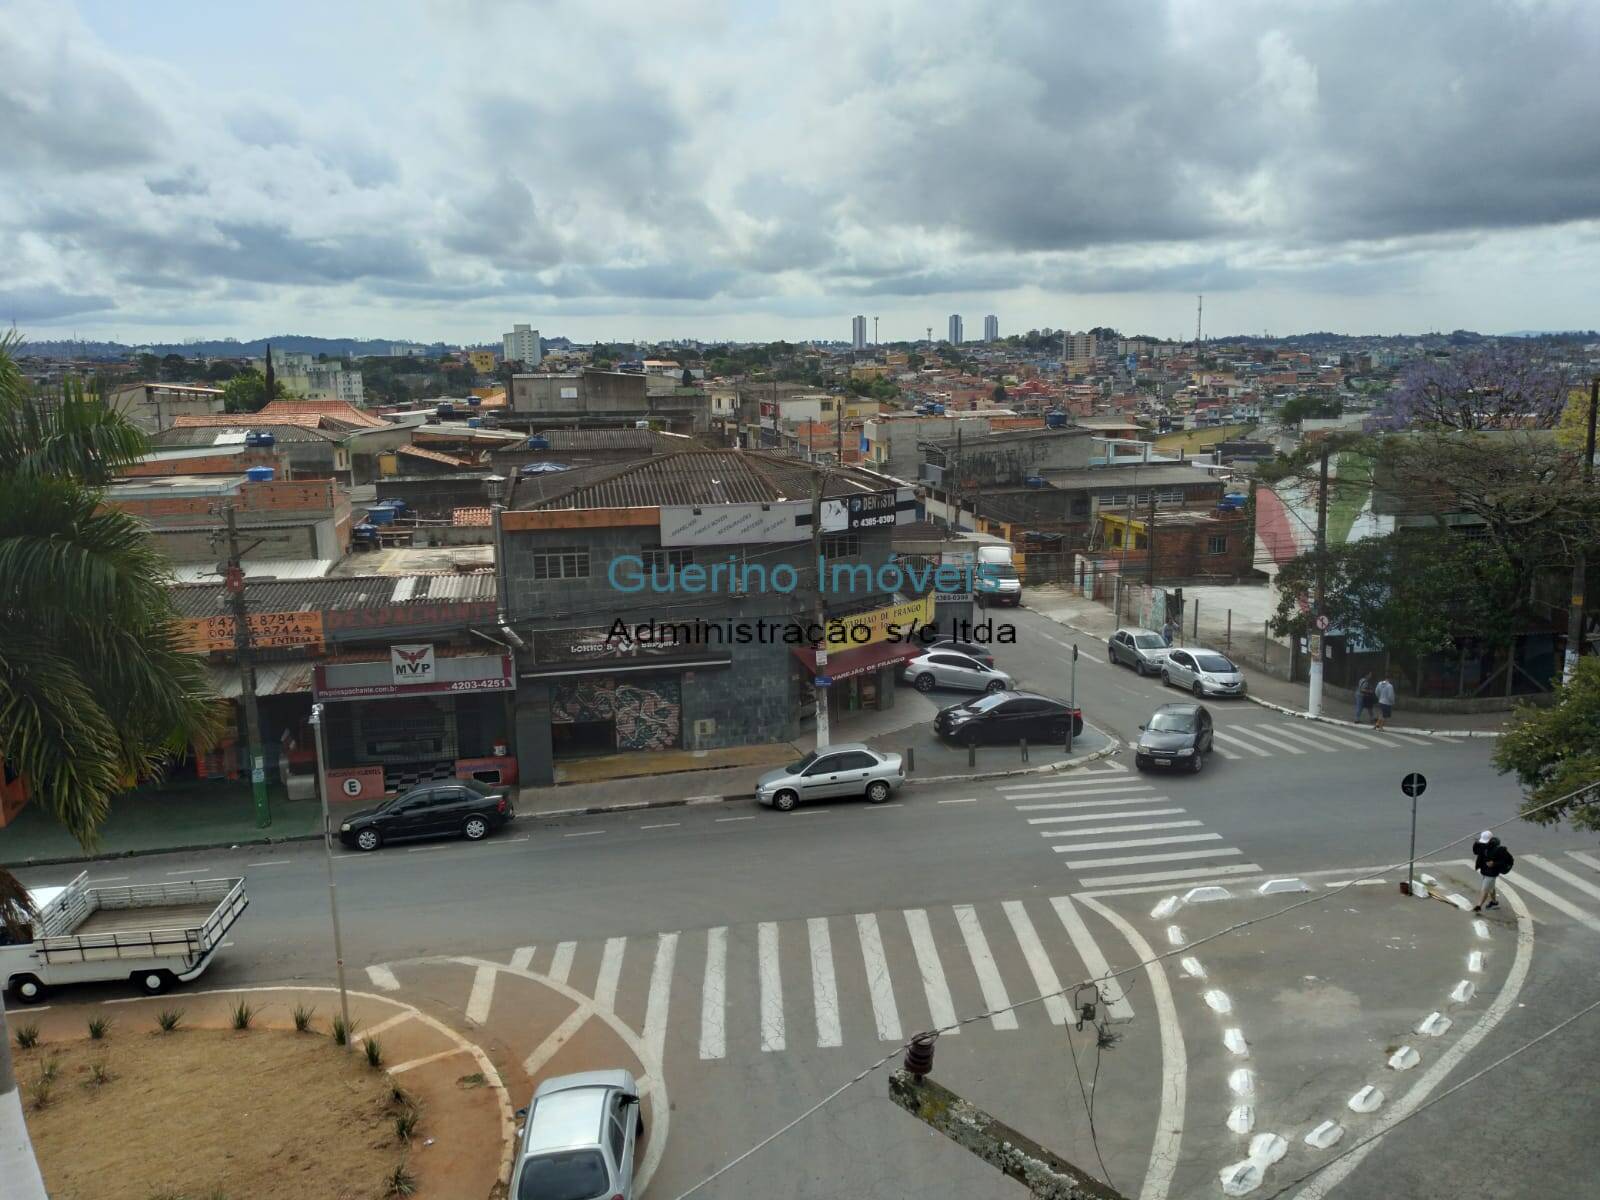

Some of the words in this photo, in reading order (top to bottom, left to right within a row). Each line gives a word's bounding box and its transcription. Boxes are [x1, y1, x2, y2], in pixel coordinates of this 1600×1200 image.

[863, 494, 895, 511] DENTISTA
[893, 603, 922, 617] FRANGO
[877, 656, 906, 668] FRANGO
[396, 663, 431, 675] MVP
[451, 679, 506, 690] 4203-4251
[348, 781, 358, 793] E
